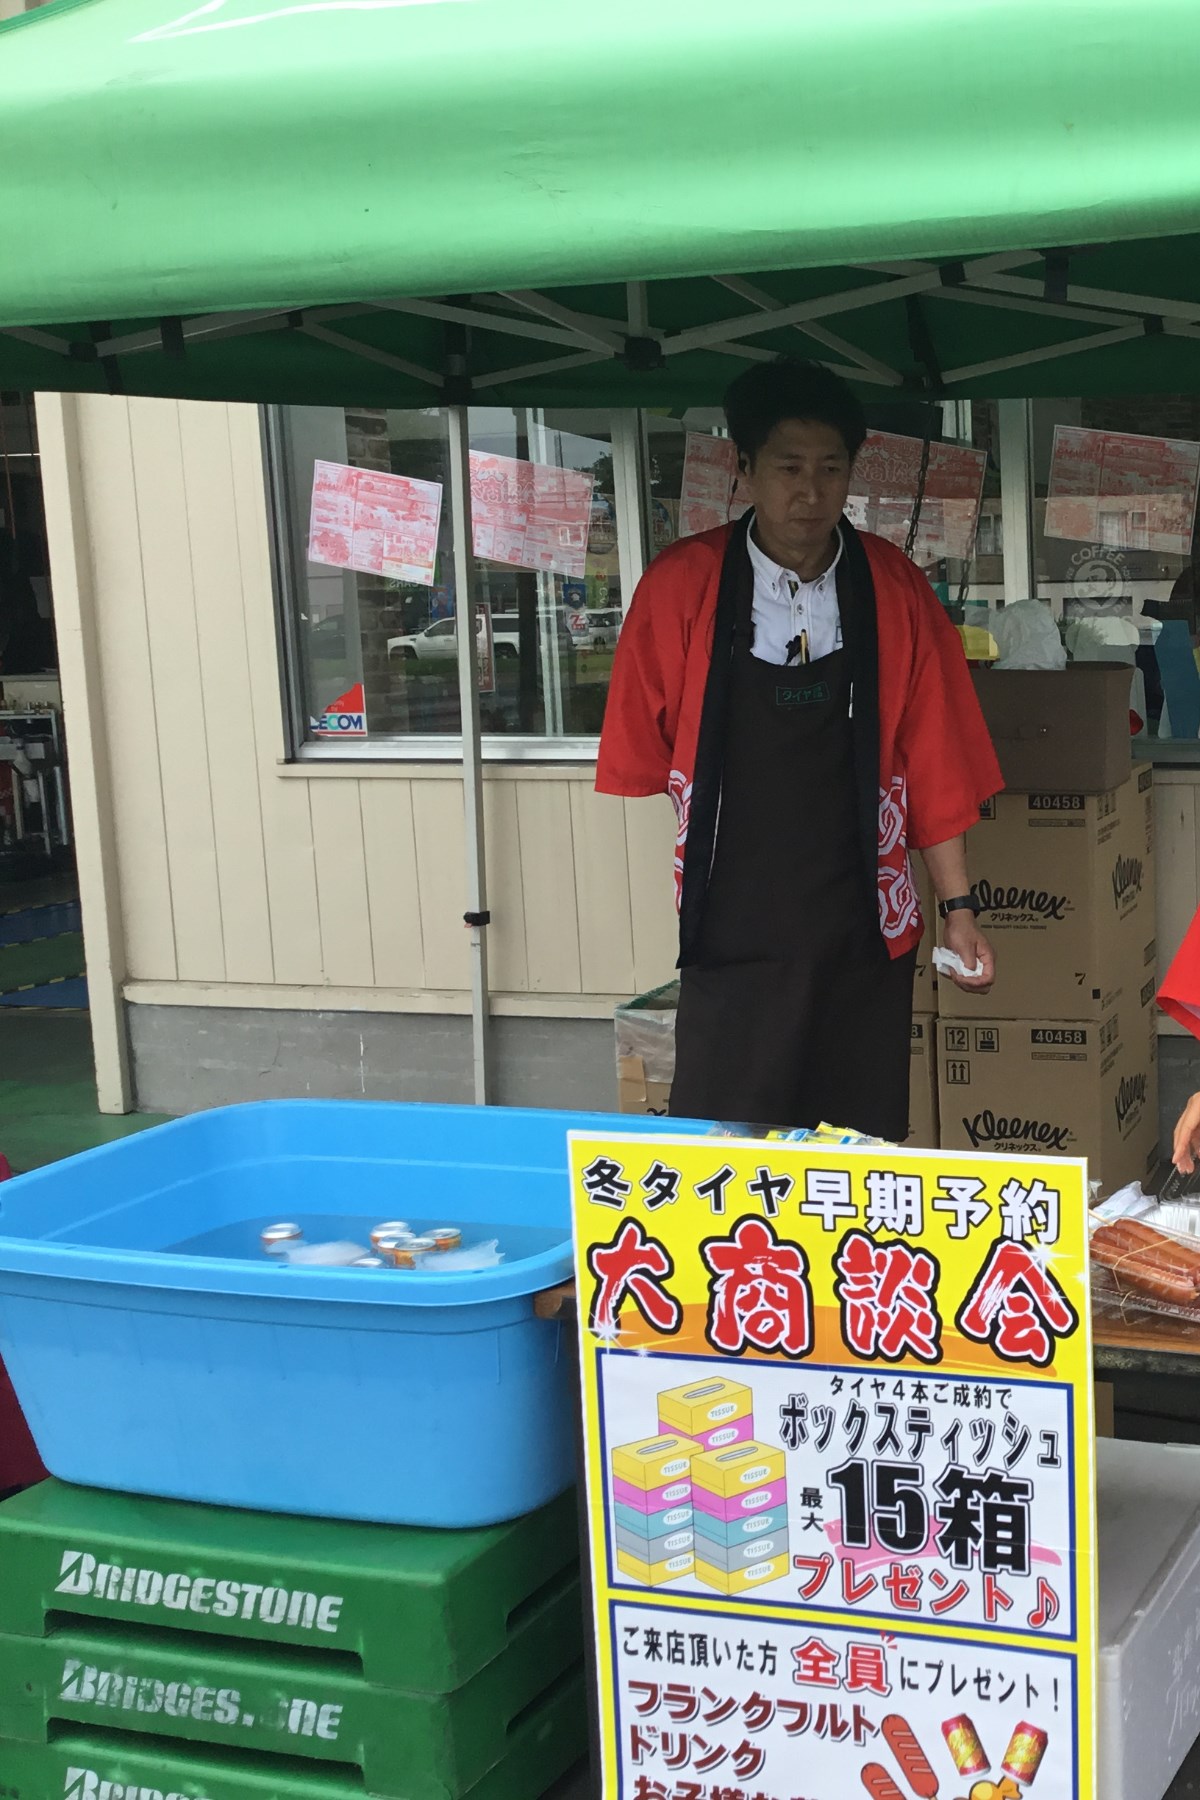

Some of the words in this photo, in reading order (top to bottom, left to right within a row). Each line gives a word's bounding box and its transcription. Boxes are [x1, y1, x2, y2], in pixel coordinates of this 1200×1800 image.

[309, 714, 363, 730] ECOM
[1033, 796, 1081, 809] 40458
[1075, 972, 1086, 985] 7
[948, 1030, 966, 1045] 12
[981, 1031, 993, 1041] 10
[1036, 1031, 1083, 1044] 40458
[962, 1110, 1069, 1150] Kleenex
[582, 1158, 1060, 1245] 冬タイヤ早期予約
[587, 1213, 1080, 1366] 大商談会
[830, 1375, 1013, 1409] タイヤ4本ご成約で
[710, 1405, 735, 1417] TISSUE
[711, 1430, 736, 1443] TISSUE
[779, 1393, 1062, 1470] ボックスティッシュ
[664, 1461, 688, 1473] TISSUE
[743, 1468, 768, 1480] TISSUE
[665, 1486, 689, 1498] TISSUE
[744, 1493, 769, 1505] TISSUE
[799, 1486, 825, 1532] 最大
[666, 1510, 690, 1523] TISSUE
[826, 1459, 1034, 1577] 15箱
[745, 1518, 770, 1530] TISSUE
[667, 1535, 691, 1548] TISSUE
[746, 1542, 771, 1555] TISSUE
[668, 1557, 692, 1569] TISSUE
[747, 1565, 772, 1577] TISSUE
[54, 1550, 344, 1633] BRIDGESTONE
[793, 1554, 1013, 1622] プレゼント
[60, 1658, 344, 1740] BRIDGESNE
[627, 1678, 880, 1747] フランクフルト
[629, 1724, 766, 1778] ドリンク
